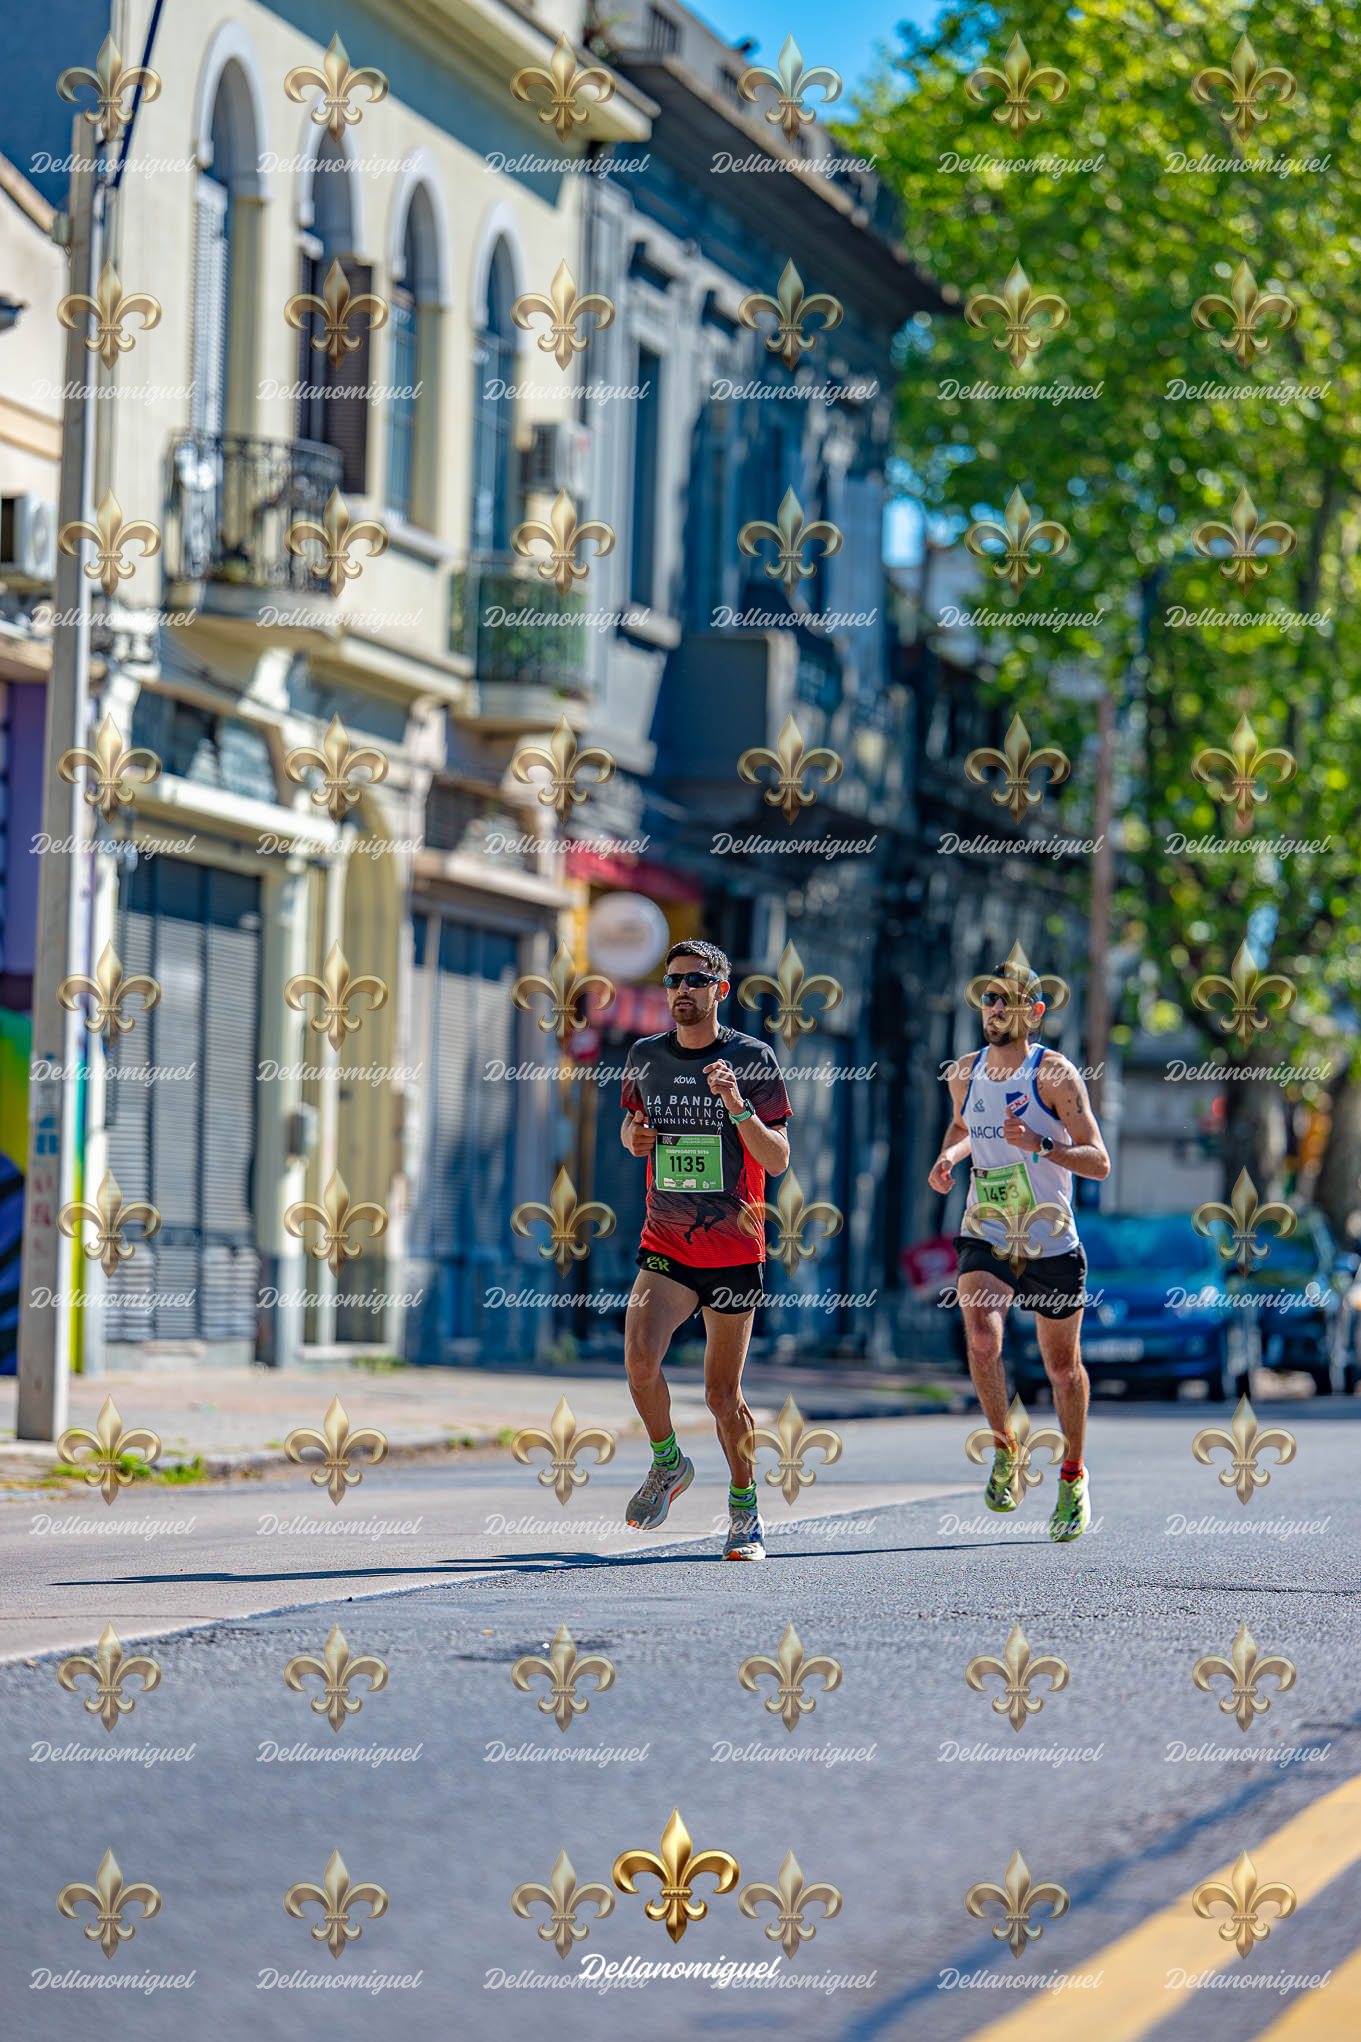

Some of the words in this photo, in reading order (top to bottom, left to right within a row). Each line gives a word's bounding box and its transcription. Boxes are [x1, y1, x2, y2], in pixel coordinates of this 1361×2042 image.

[646, 1095, 662, 1106] LA
[669, 1095, 724, 1108] BANDA
[647, 1106, 724, 1119] TRAINING
[699, 1119, 724, 1128] TEAM
[970, 1125, 1005, 1139] NACIO
[669, 1155, 706, 1173] 1135
[983, 1184, 1020, 1203] 1453
